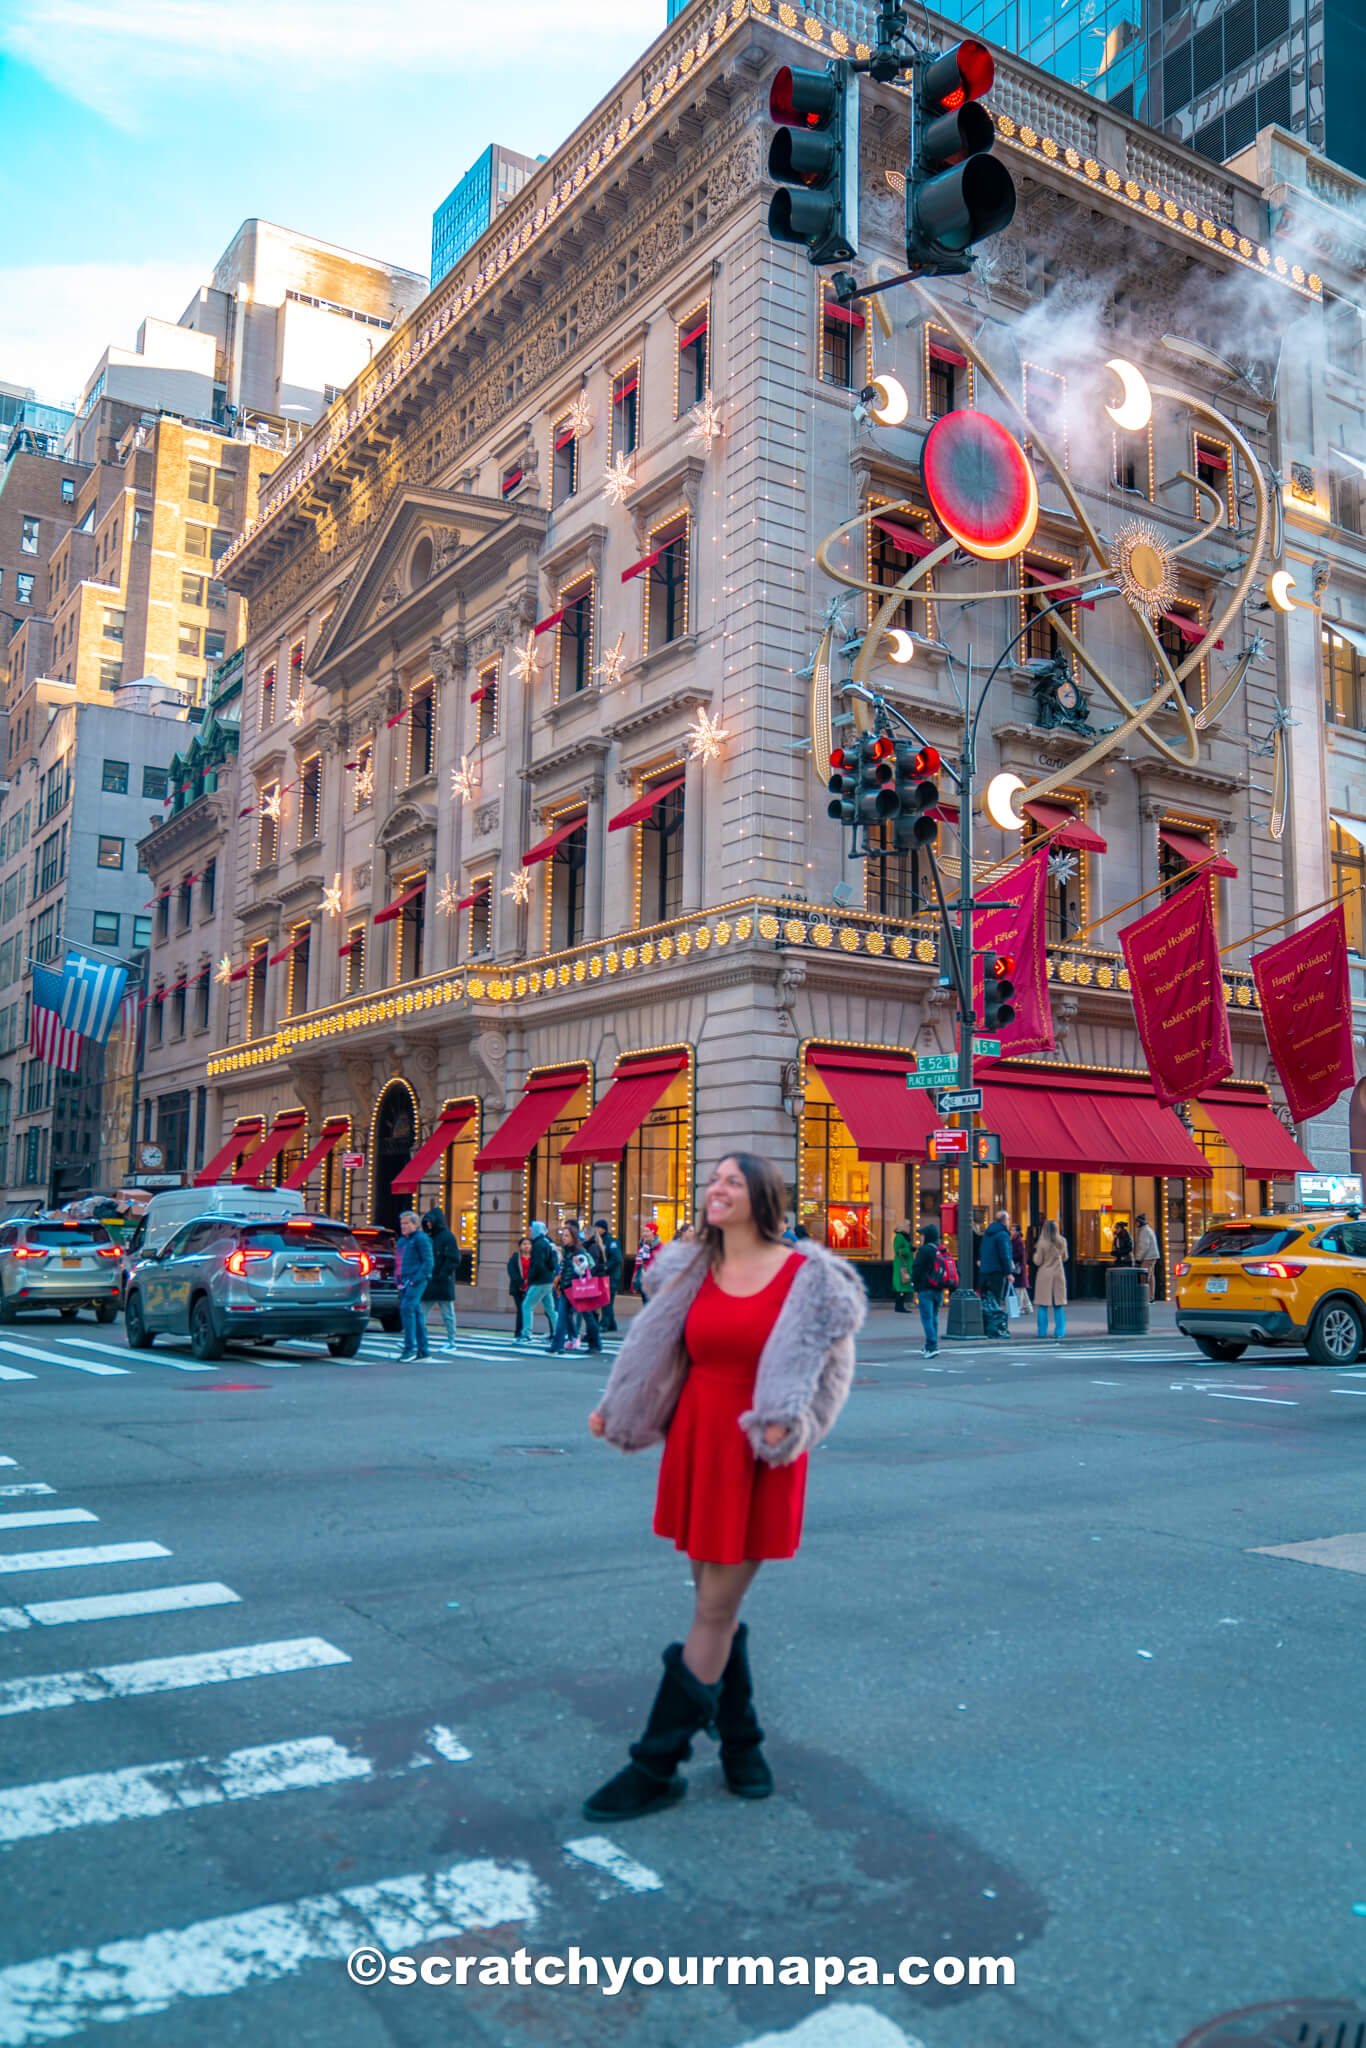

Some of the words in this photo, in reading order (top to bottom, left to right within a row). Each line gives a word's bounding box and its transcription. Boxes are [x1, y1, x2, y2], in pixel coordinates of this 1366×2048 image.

[1143, 943, 1167, 965] Happy
[1271, 970, 1296, 987] Happy
[918, 1059, 926, 1071] E
[929, 1057, 943, 1070] 52
[908, 1075, 925, 1086] PLACE
[944, 1098, 956, 1106] ONE
[961, 1095, 976, 1104] WAY
